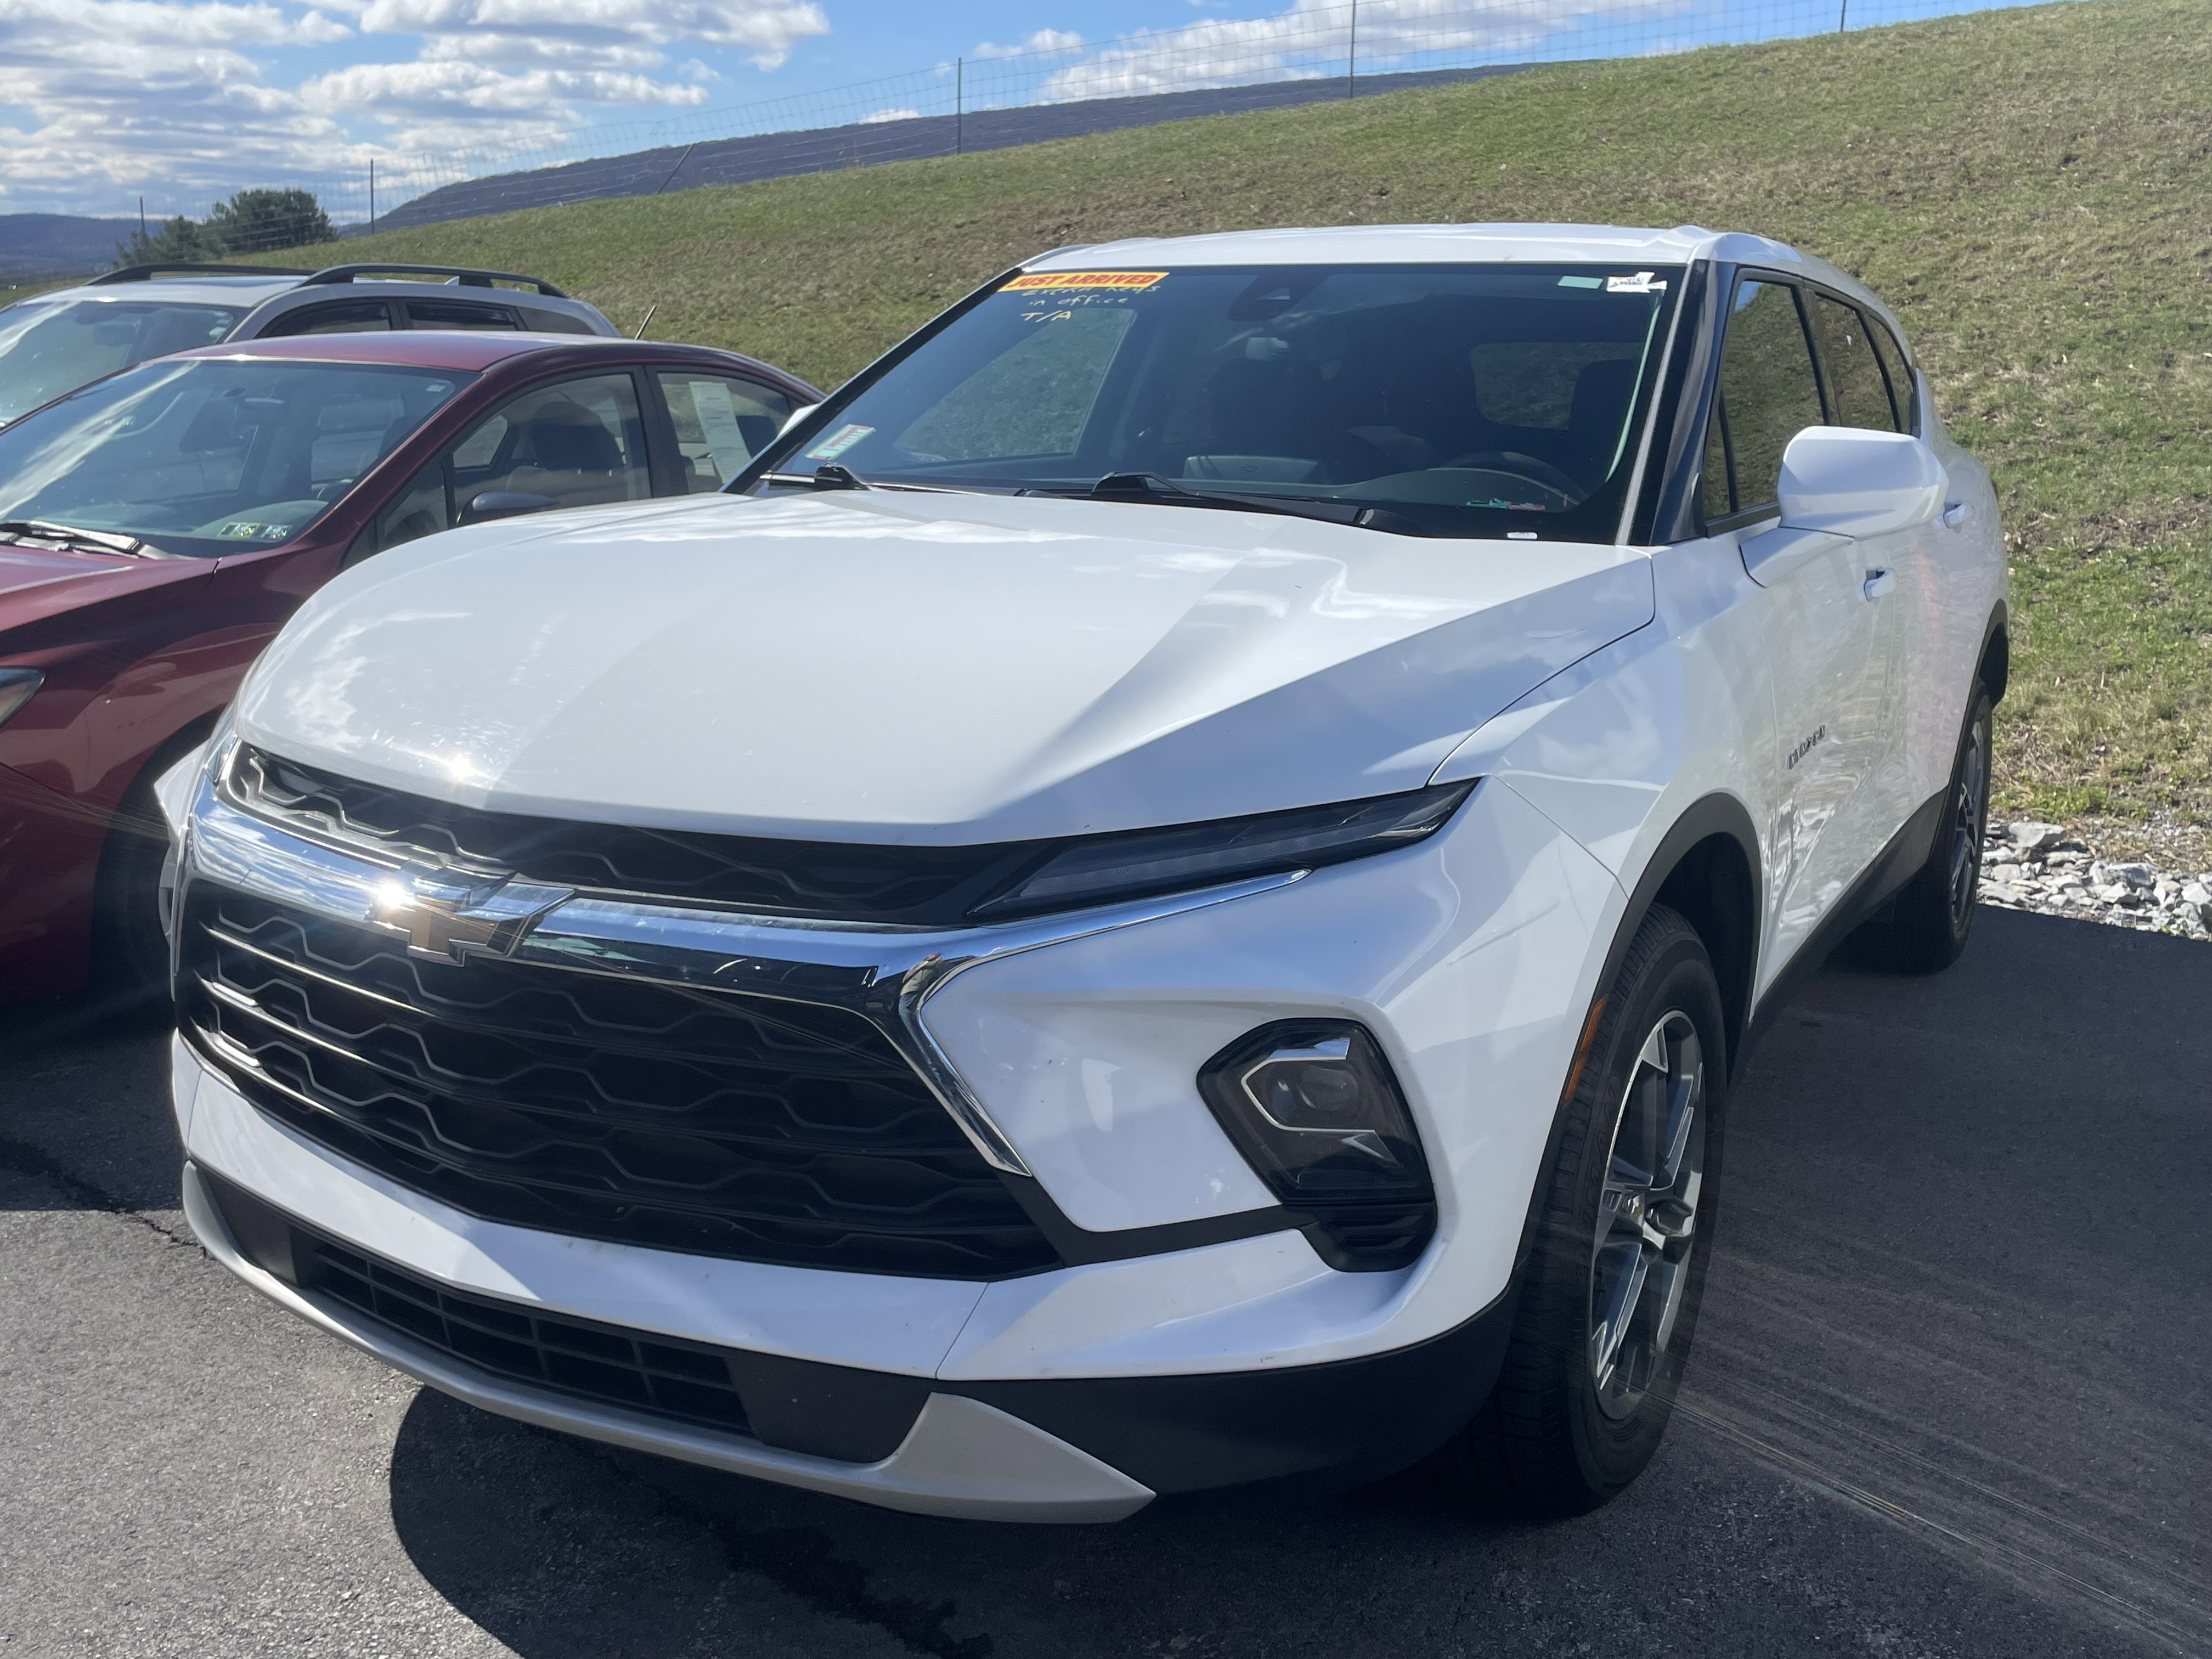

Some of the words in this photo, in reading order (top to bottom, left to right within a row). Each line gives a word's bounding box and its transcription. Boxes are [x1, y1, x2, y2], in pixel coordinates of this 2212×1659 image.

[1006, 275, 1066, 288] JUST
[1058, 274, 1159, 285] ARRIVED
[1057, 295, 1128, 306] office
[1020, 309, 1072, 323] T/A
